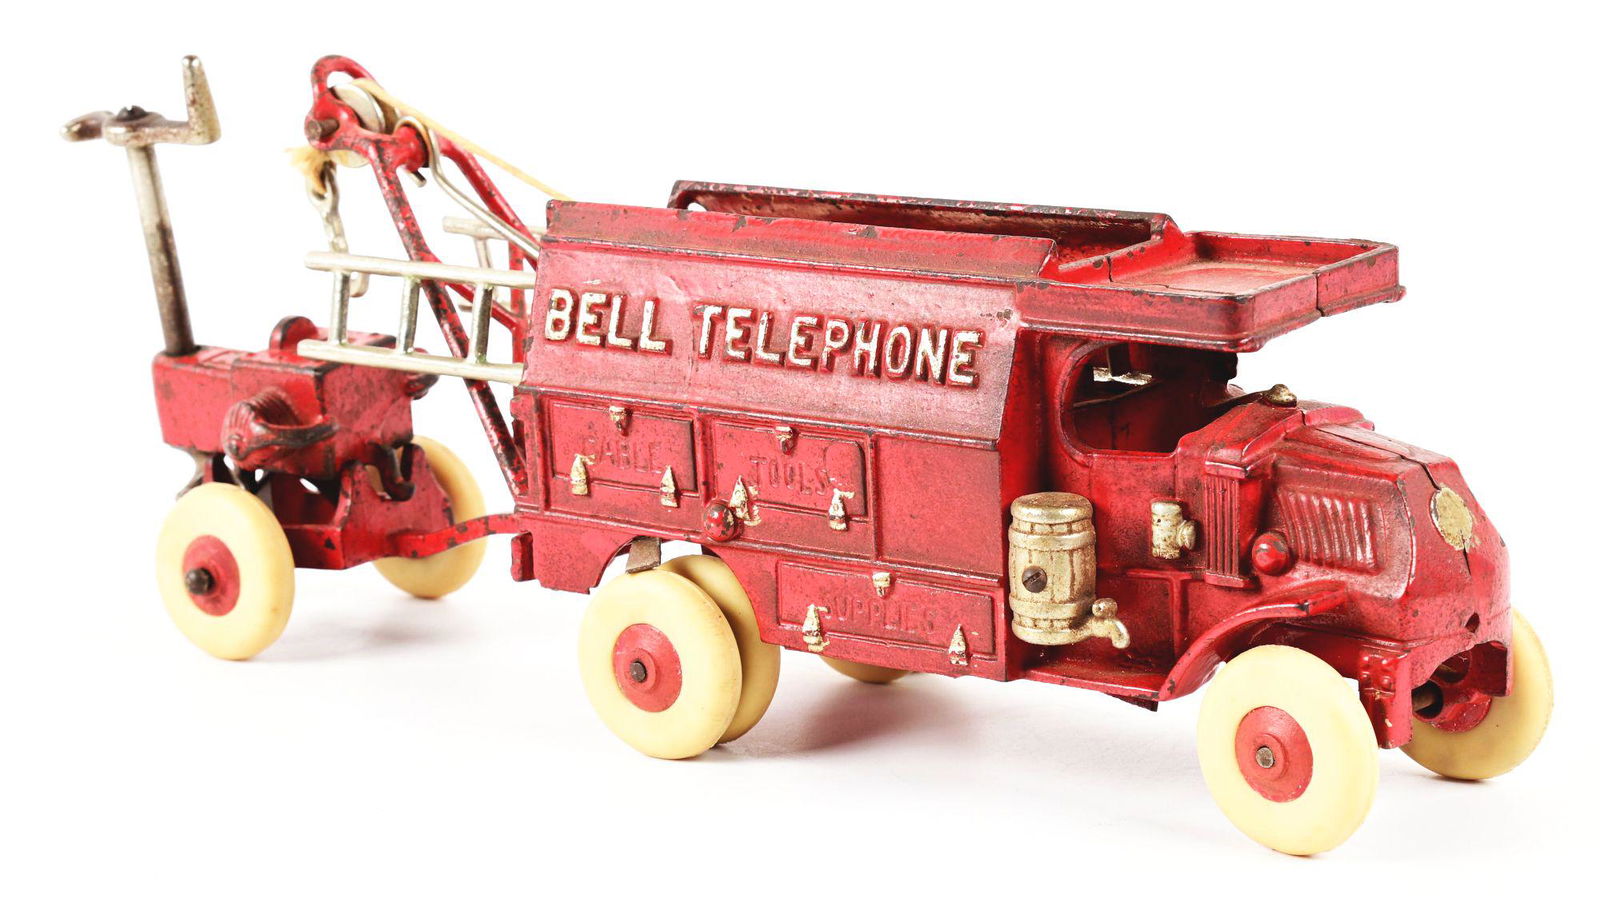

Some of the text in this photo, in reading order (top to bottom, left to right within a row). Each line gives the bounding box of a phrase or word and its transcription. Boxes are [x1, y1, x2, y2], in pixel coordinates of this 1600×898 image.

[544, 288, 984, 388] BELL TELEPHONE
[749, 455, 828, 496] TOOLS
